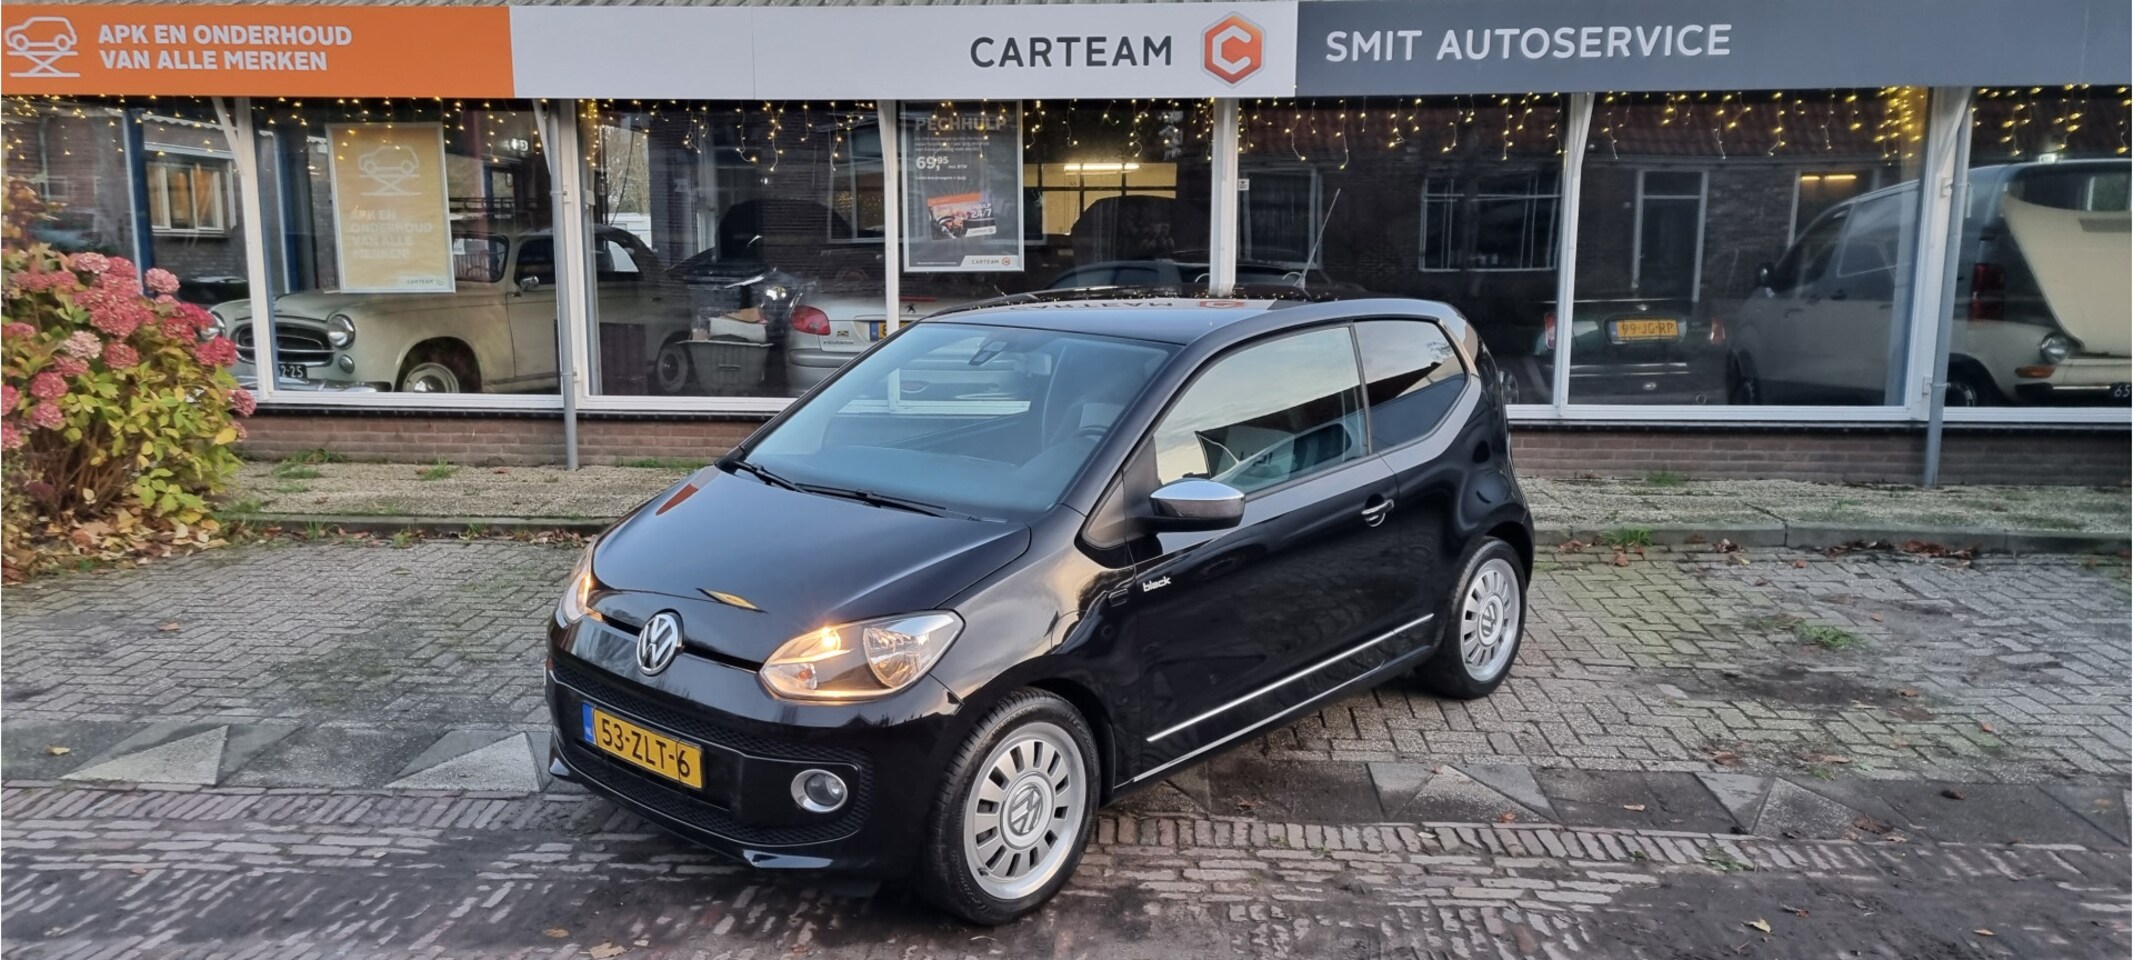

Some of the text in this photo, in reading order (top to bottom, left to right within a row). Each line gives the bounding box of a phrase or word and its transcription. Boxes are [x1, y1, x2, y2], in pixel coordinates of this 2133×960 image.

[99, 24, 353, 46] APK EN ONDERHOUD
[1326, 23, 1733, 62] SMIT AUTOSERVICE
[100, 50, 328, 71] VAN ALLE MERKEN
[970, 35, 1172, 68] CARTEAM
[915, 117, 1007, 131] PECHHULP
[1142, 575, 1172, 593] black
[601, 718, 691, 778] 53-ZLT-6
